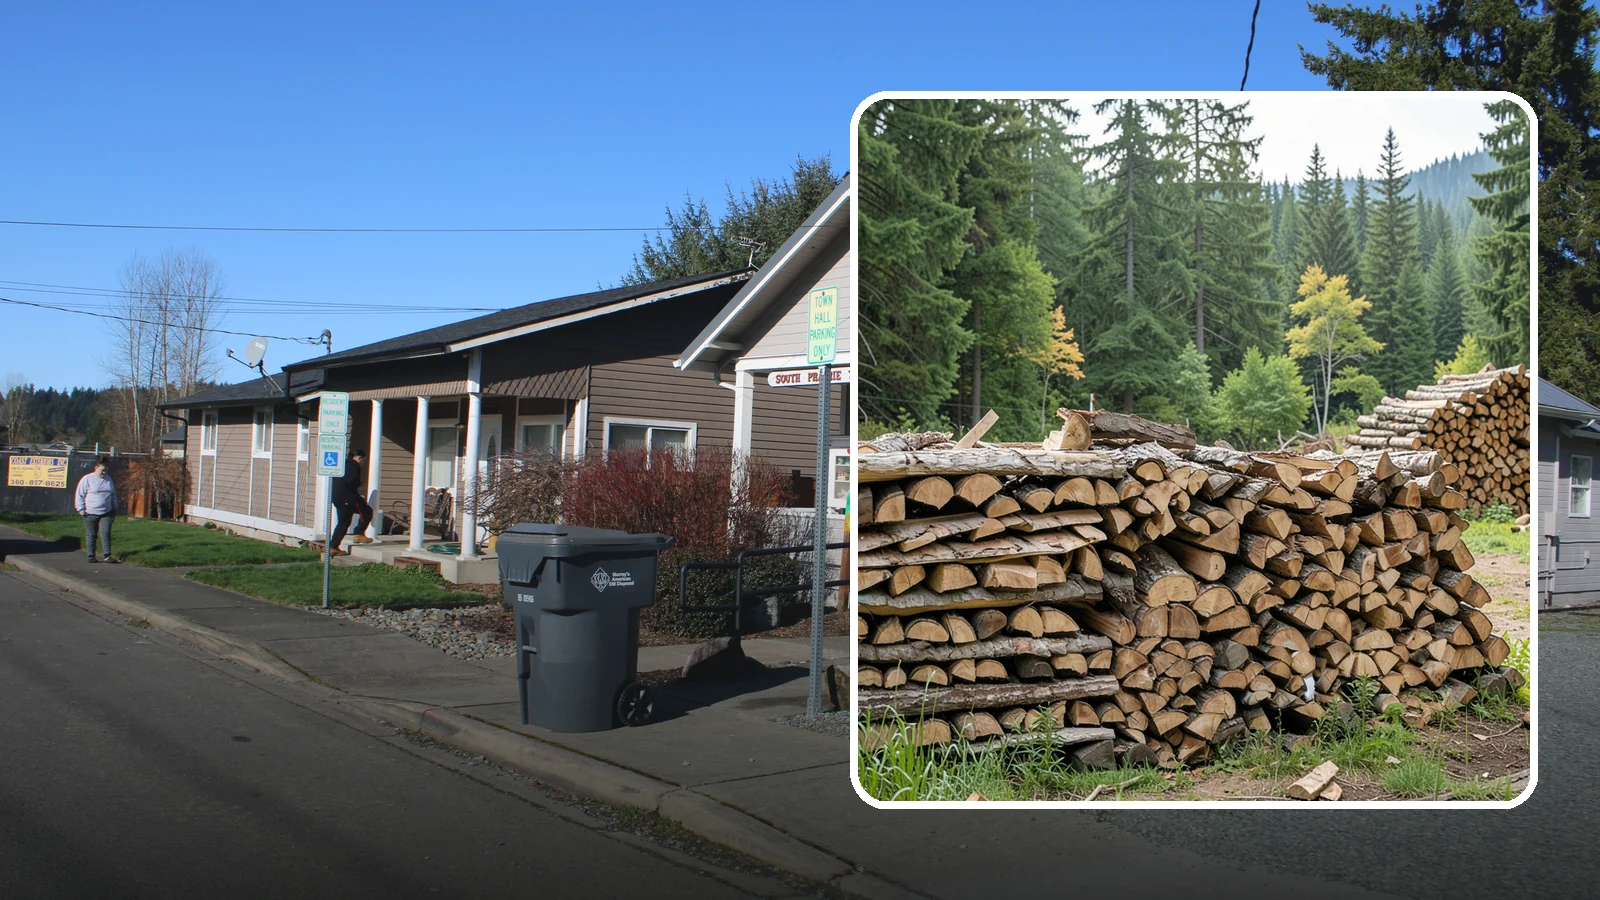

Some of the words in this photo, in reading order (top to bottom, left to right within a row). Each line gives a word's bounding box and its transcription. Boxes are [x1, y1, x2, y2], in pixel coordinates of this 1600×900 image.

[815, 295, 833, 307] TOWN
[815, 312, 831, 324] HALL
[810, 327, 836, 340] PARKING
[814, 345, 830, 357] ONLY
[775, 373, 801, 384] SOUTH
